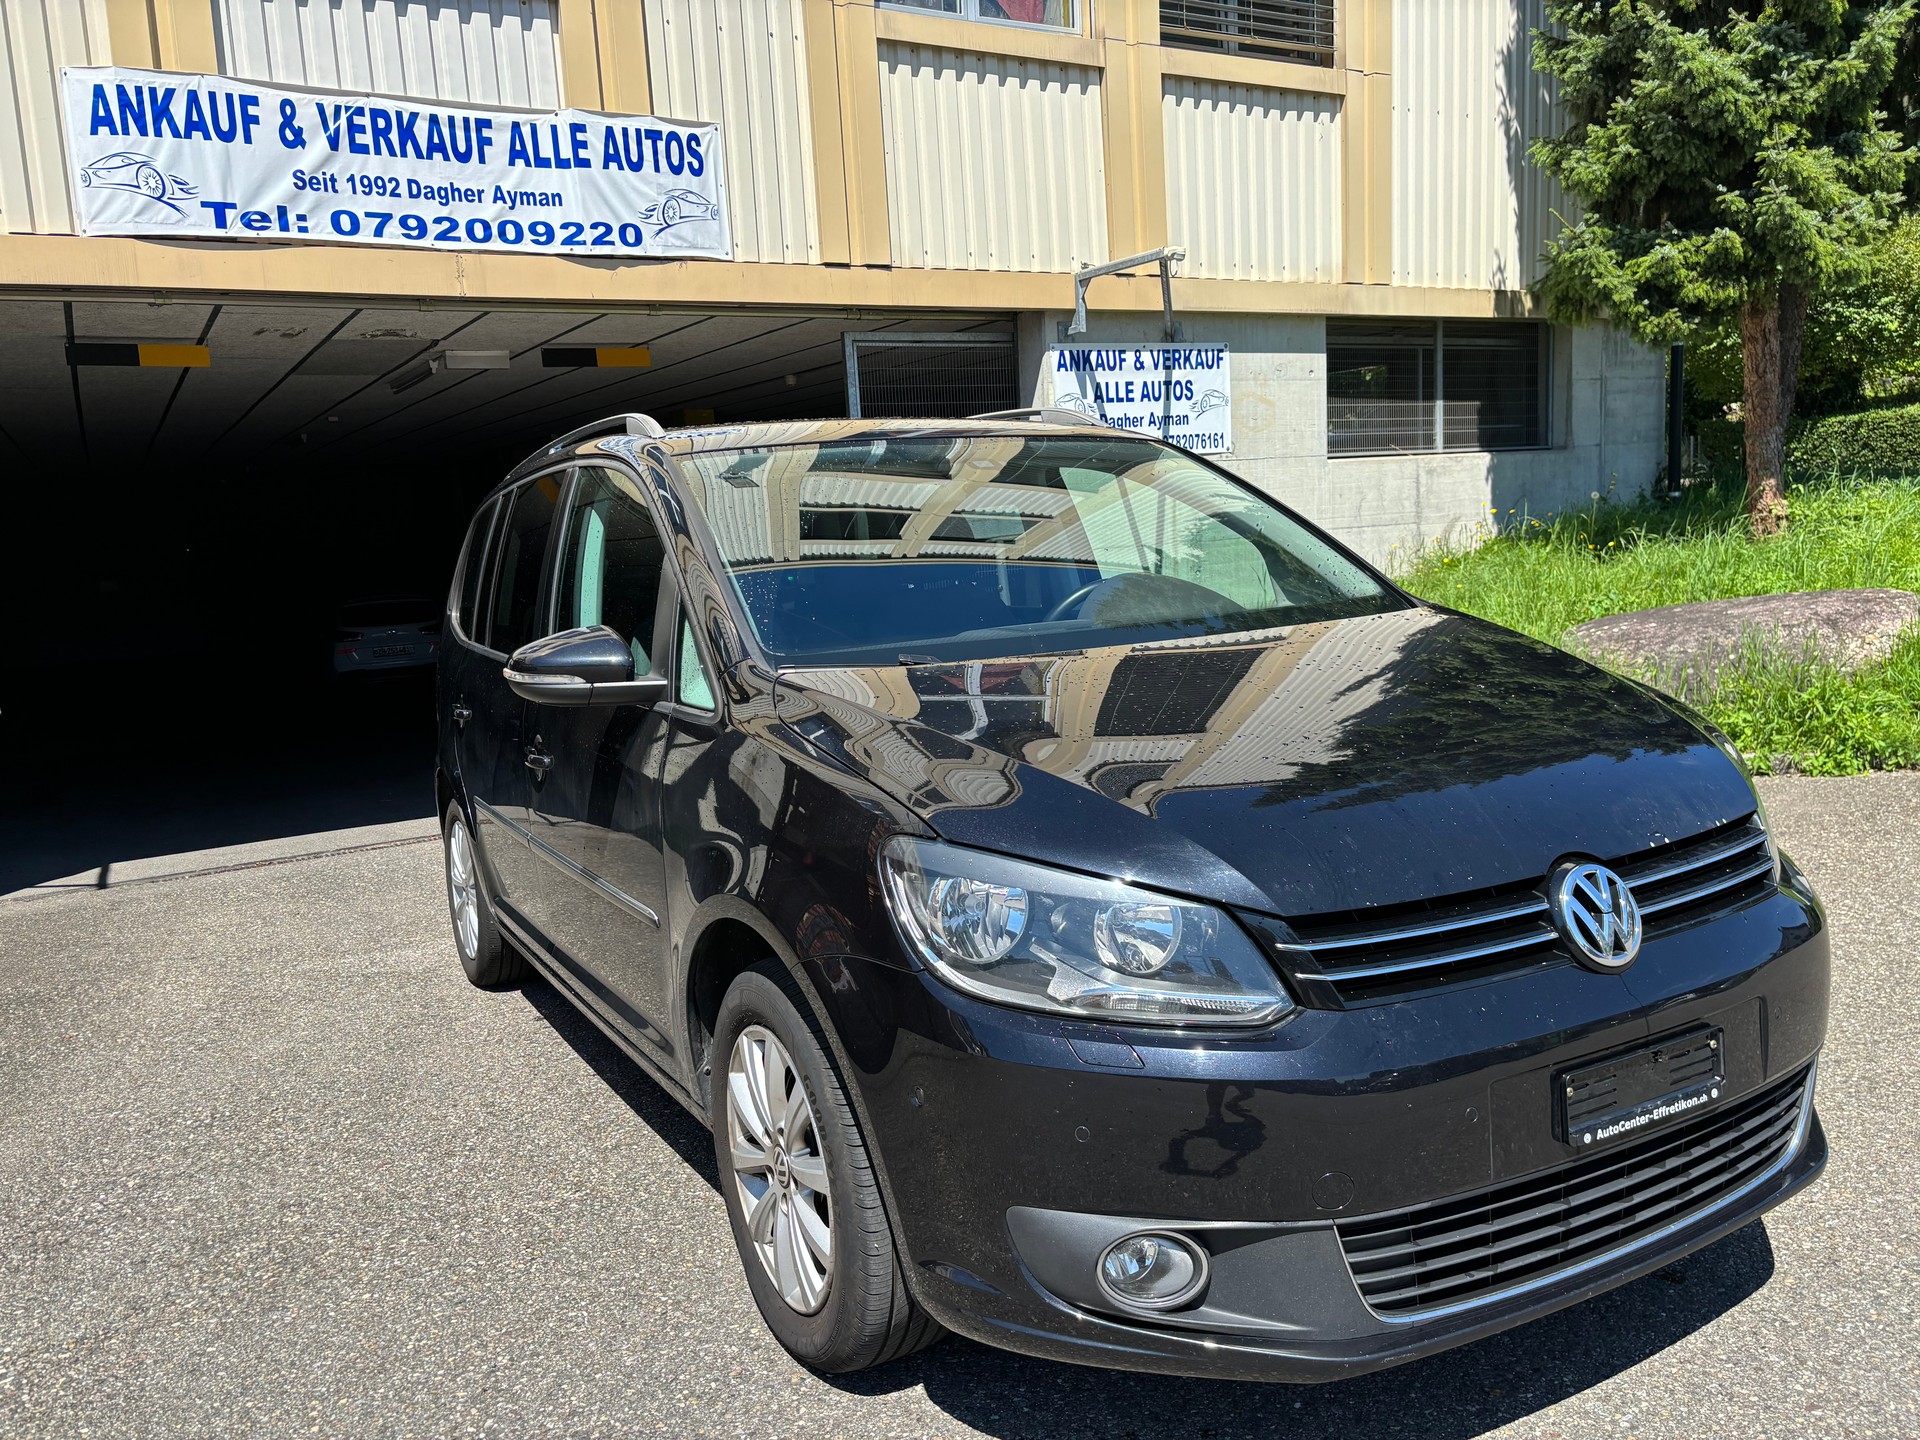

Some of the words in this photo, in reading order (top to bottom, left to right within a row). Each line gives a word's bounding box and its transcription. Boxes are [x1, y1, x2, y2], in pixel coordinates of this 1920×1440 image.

[90, 84, 261, 145] ANKAUF
[278, 98, 307, 149] &
[315, 102, 493, 165] VERKAUF
[507, 121, 592, 170] ALLE
[602, 126, 704, 178] AUTOS
[292, 169, 339, 194] Seit
[347, 173, 402, 198] 1992
[407, 179, 485, 206] Dagher
[492, 185, 563, 211] Ayman
[200, 201, 308, 234] Tel:
[331, 209, 643, 248] 0792009220
[1057, 348, 1127, 372] ANKAUF
[1134, 348, 1146, 371] &
[1150, 348, 1225, 371] VERKAUF
[1093, 381, 1135, 403] ALLE
[1140, 379, 1194, 402] AUTOS
[1148, 411, 1189, 430] Ayman
[1596, 1094, 1708, 1141] AutoCenter-Effretikon.ch
